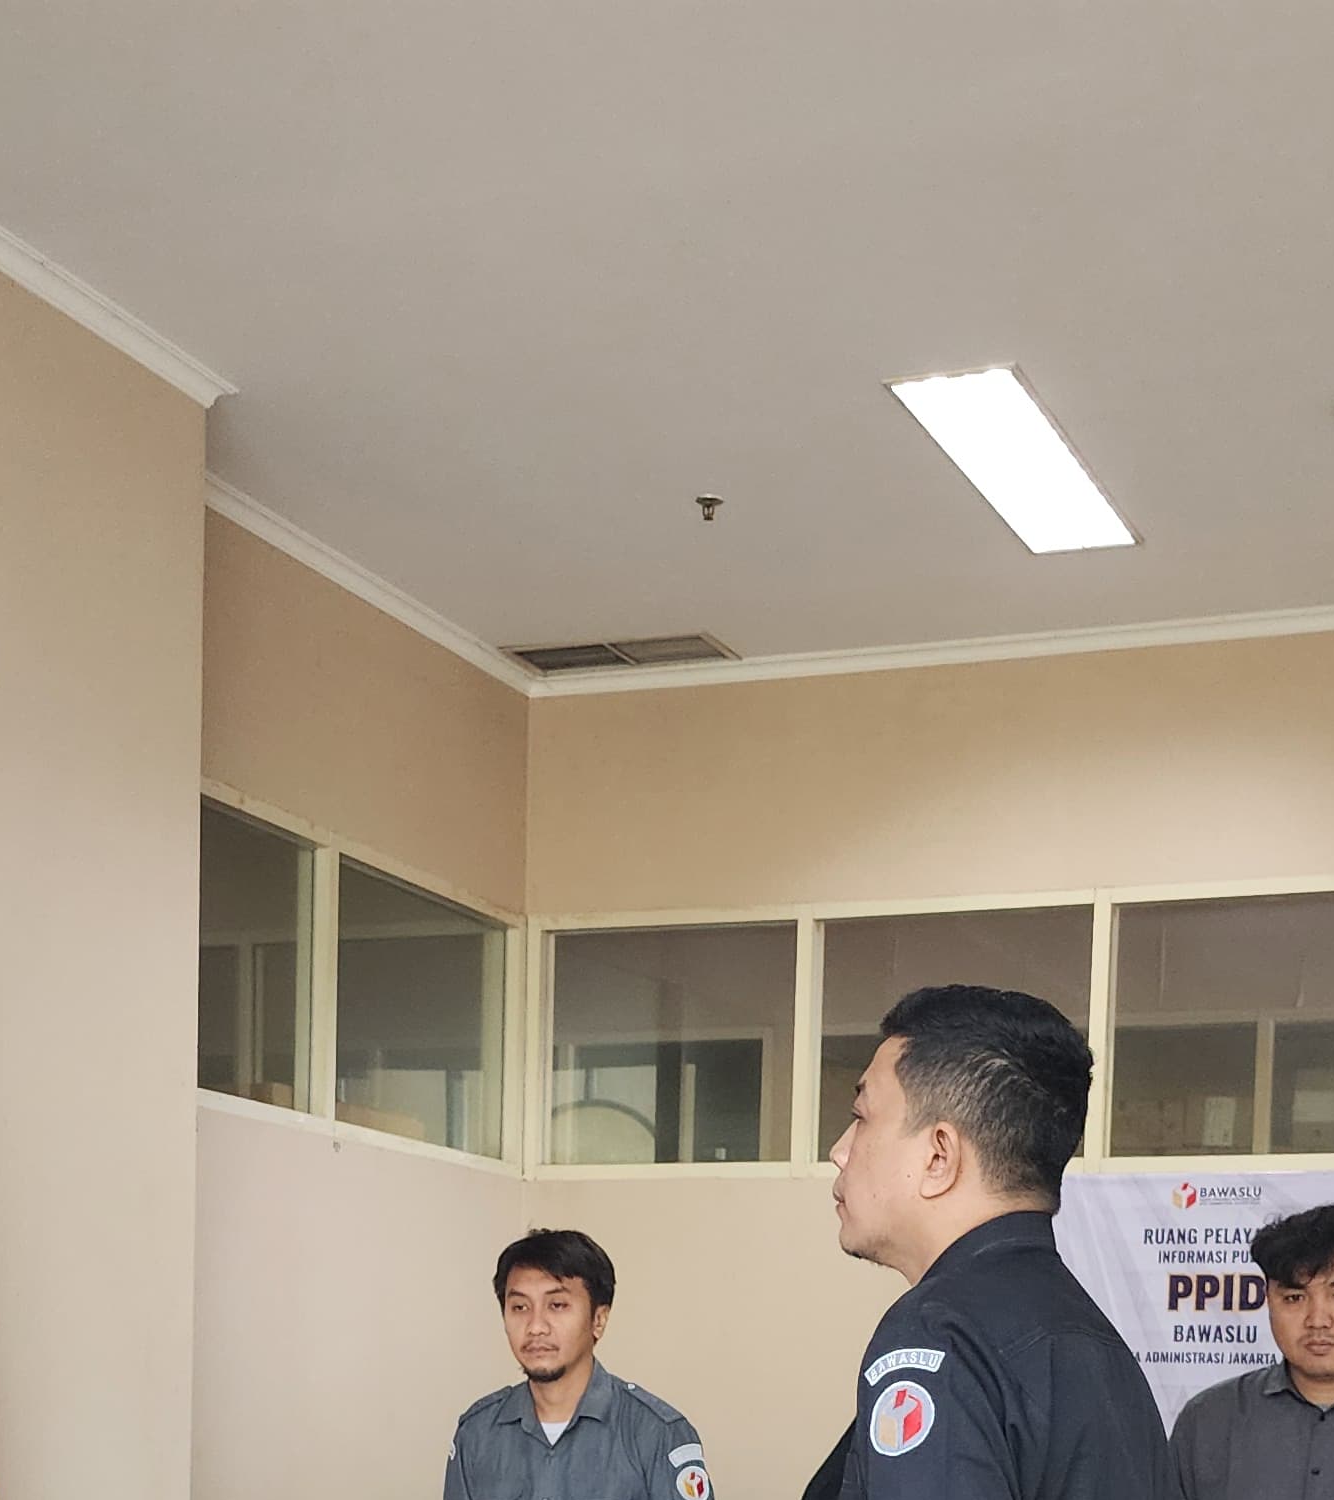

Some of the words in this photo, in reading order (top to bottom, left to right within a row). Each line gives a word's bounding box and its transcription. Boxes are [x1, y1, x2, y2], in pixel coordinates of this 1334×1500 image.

[1199, 1186, 1262, 1198] BAWASLU
[1143, 1228, 1198, 1245] RUANG
[1204, 1228, 1254, 1245] PELAY
[1158, 1250, 1228, 1264] INFORMASI
[1232, 1250, 1254, 1264] PU
[1167, 1273, 1267, 1311] PPID
[1173, 1325, 1258, 1344] BAWASLU
[868, 1351, 940, 1381] BAWASLU
[1145, 1351, 1225, 1365] ADMINISTRASI
[1228, 1352, 1277, 1366] JAKARTA
